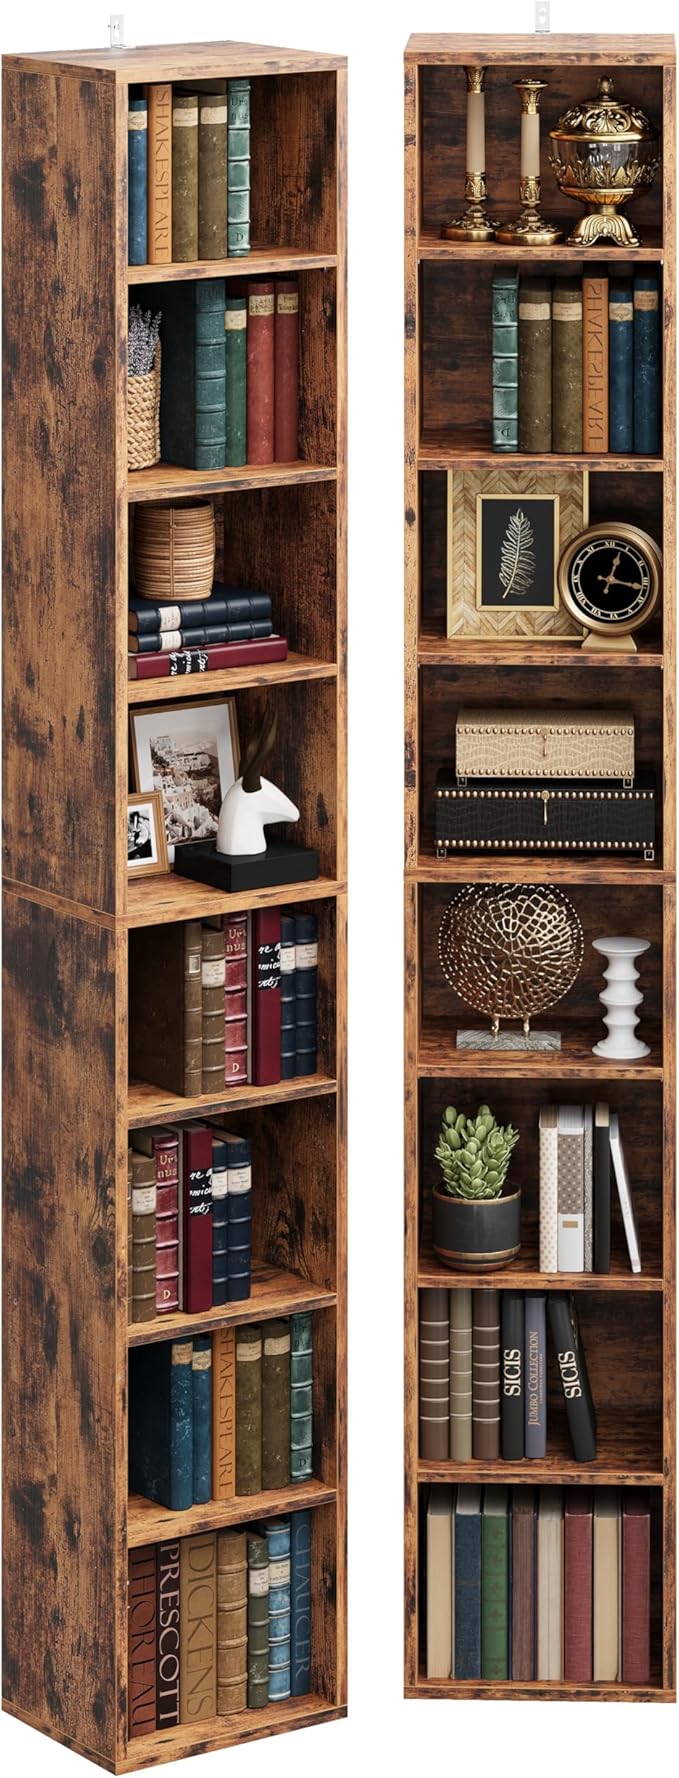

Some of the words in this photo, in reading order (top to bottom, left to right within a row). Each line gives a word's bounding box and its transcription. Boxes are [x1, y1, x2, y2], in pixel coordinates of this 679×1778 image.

[155, 90, 170, 256] SHAKESPEARE
[236, 232, 244, 242] D
[231, 1062, 240, 1073] D
[162, 1289, 171, 1300] D
[503, 1349, 521, 1396] SICIS
[528, 1331, 538, 1391] COLLECTION
[558, 1351, 582, 1398] SICIS
[219, 1328, 234, 1489] SHAKESPEARE
[528, 1393, 541, 1426] JUMBO
[299, 1458, 307, 1468] D
[294, 1524, 311, 1681] CHAUCER
[131, 1553, 155, 1728] THOREAU
[159, 1545, 180, 1723] PRESCOTT
[187, 1543, 214, 1716] DICKENS
